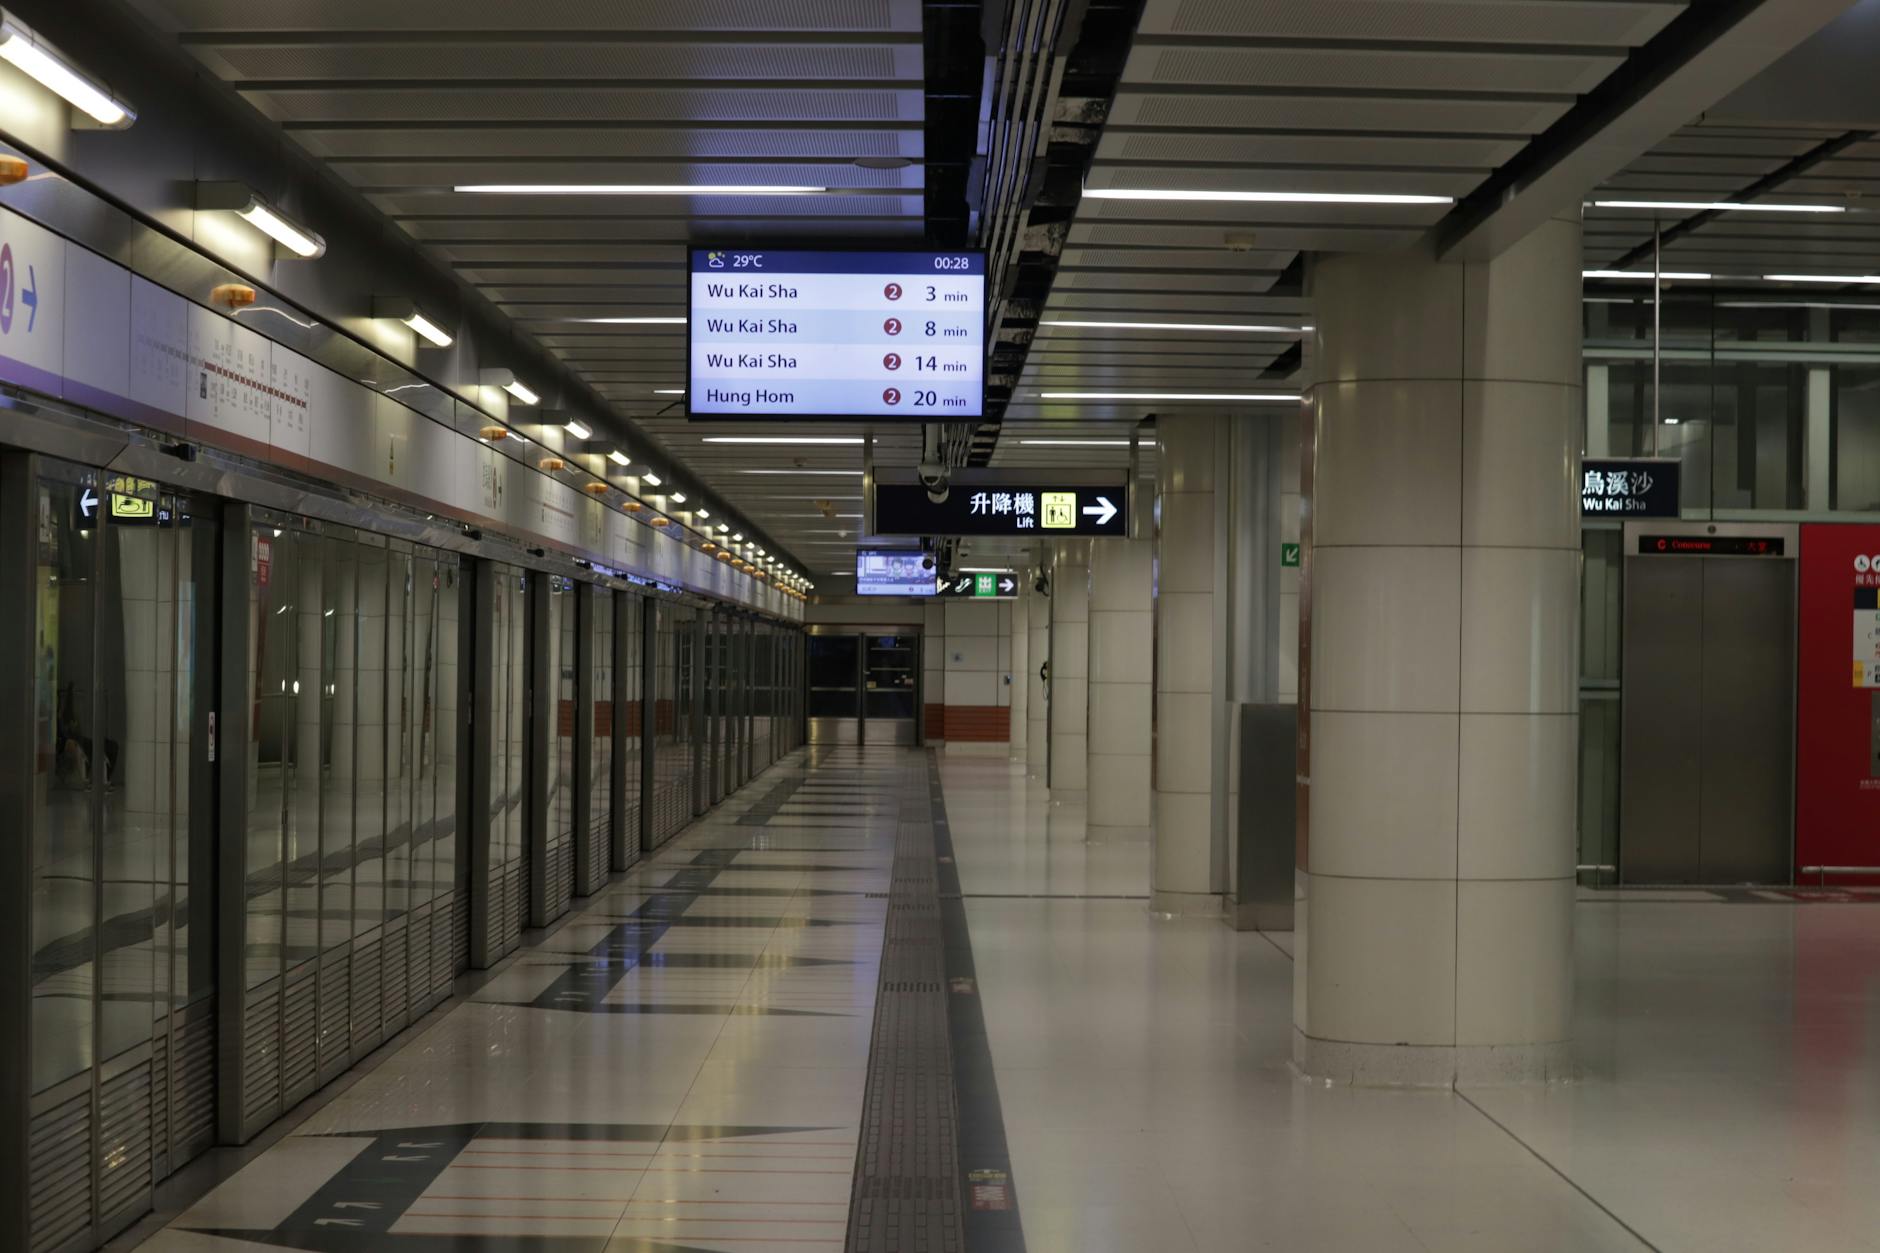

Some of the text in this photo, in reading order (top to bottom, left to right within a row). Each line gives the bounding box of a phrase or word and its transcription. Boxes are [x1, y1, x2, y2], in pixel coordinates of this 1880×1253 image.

[934, 256, 969, 270] 00:28
[708, 284, 734, 298] Wu
[739, 284, 763, 298] Kai
[768, 284, 798, 298] Sha
[925, 286, 936, 302] 3
[944, 292, 968, 302] min
[708, 319, 733, 333] Wu
[739, 319, 763, 333] Kai
[768, 319, 797, 333] Sha
[925, 321, 936, 337] 8
[944, 327, 968, 337] min
[708, 354, 733, 368] Wu
[738, 354, 763, 368] Kai
[768, 354, 797, 368] Sha
[915, 355, 937, 371] 14
[943, 362, 967, 372] min
[707, 389, 750, 407] Hung
[756, 389, 794, 403] Hom
[913, 391, 937, 407] 20
[943, 396, 967, 407] min
[970, 492, 1035, 516] 升降機
[1583, 497, 1647, 511] Wu Kai Sha
[1016, 516, 1034, 529] Lift
